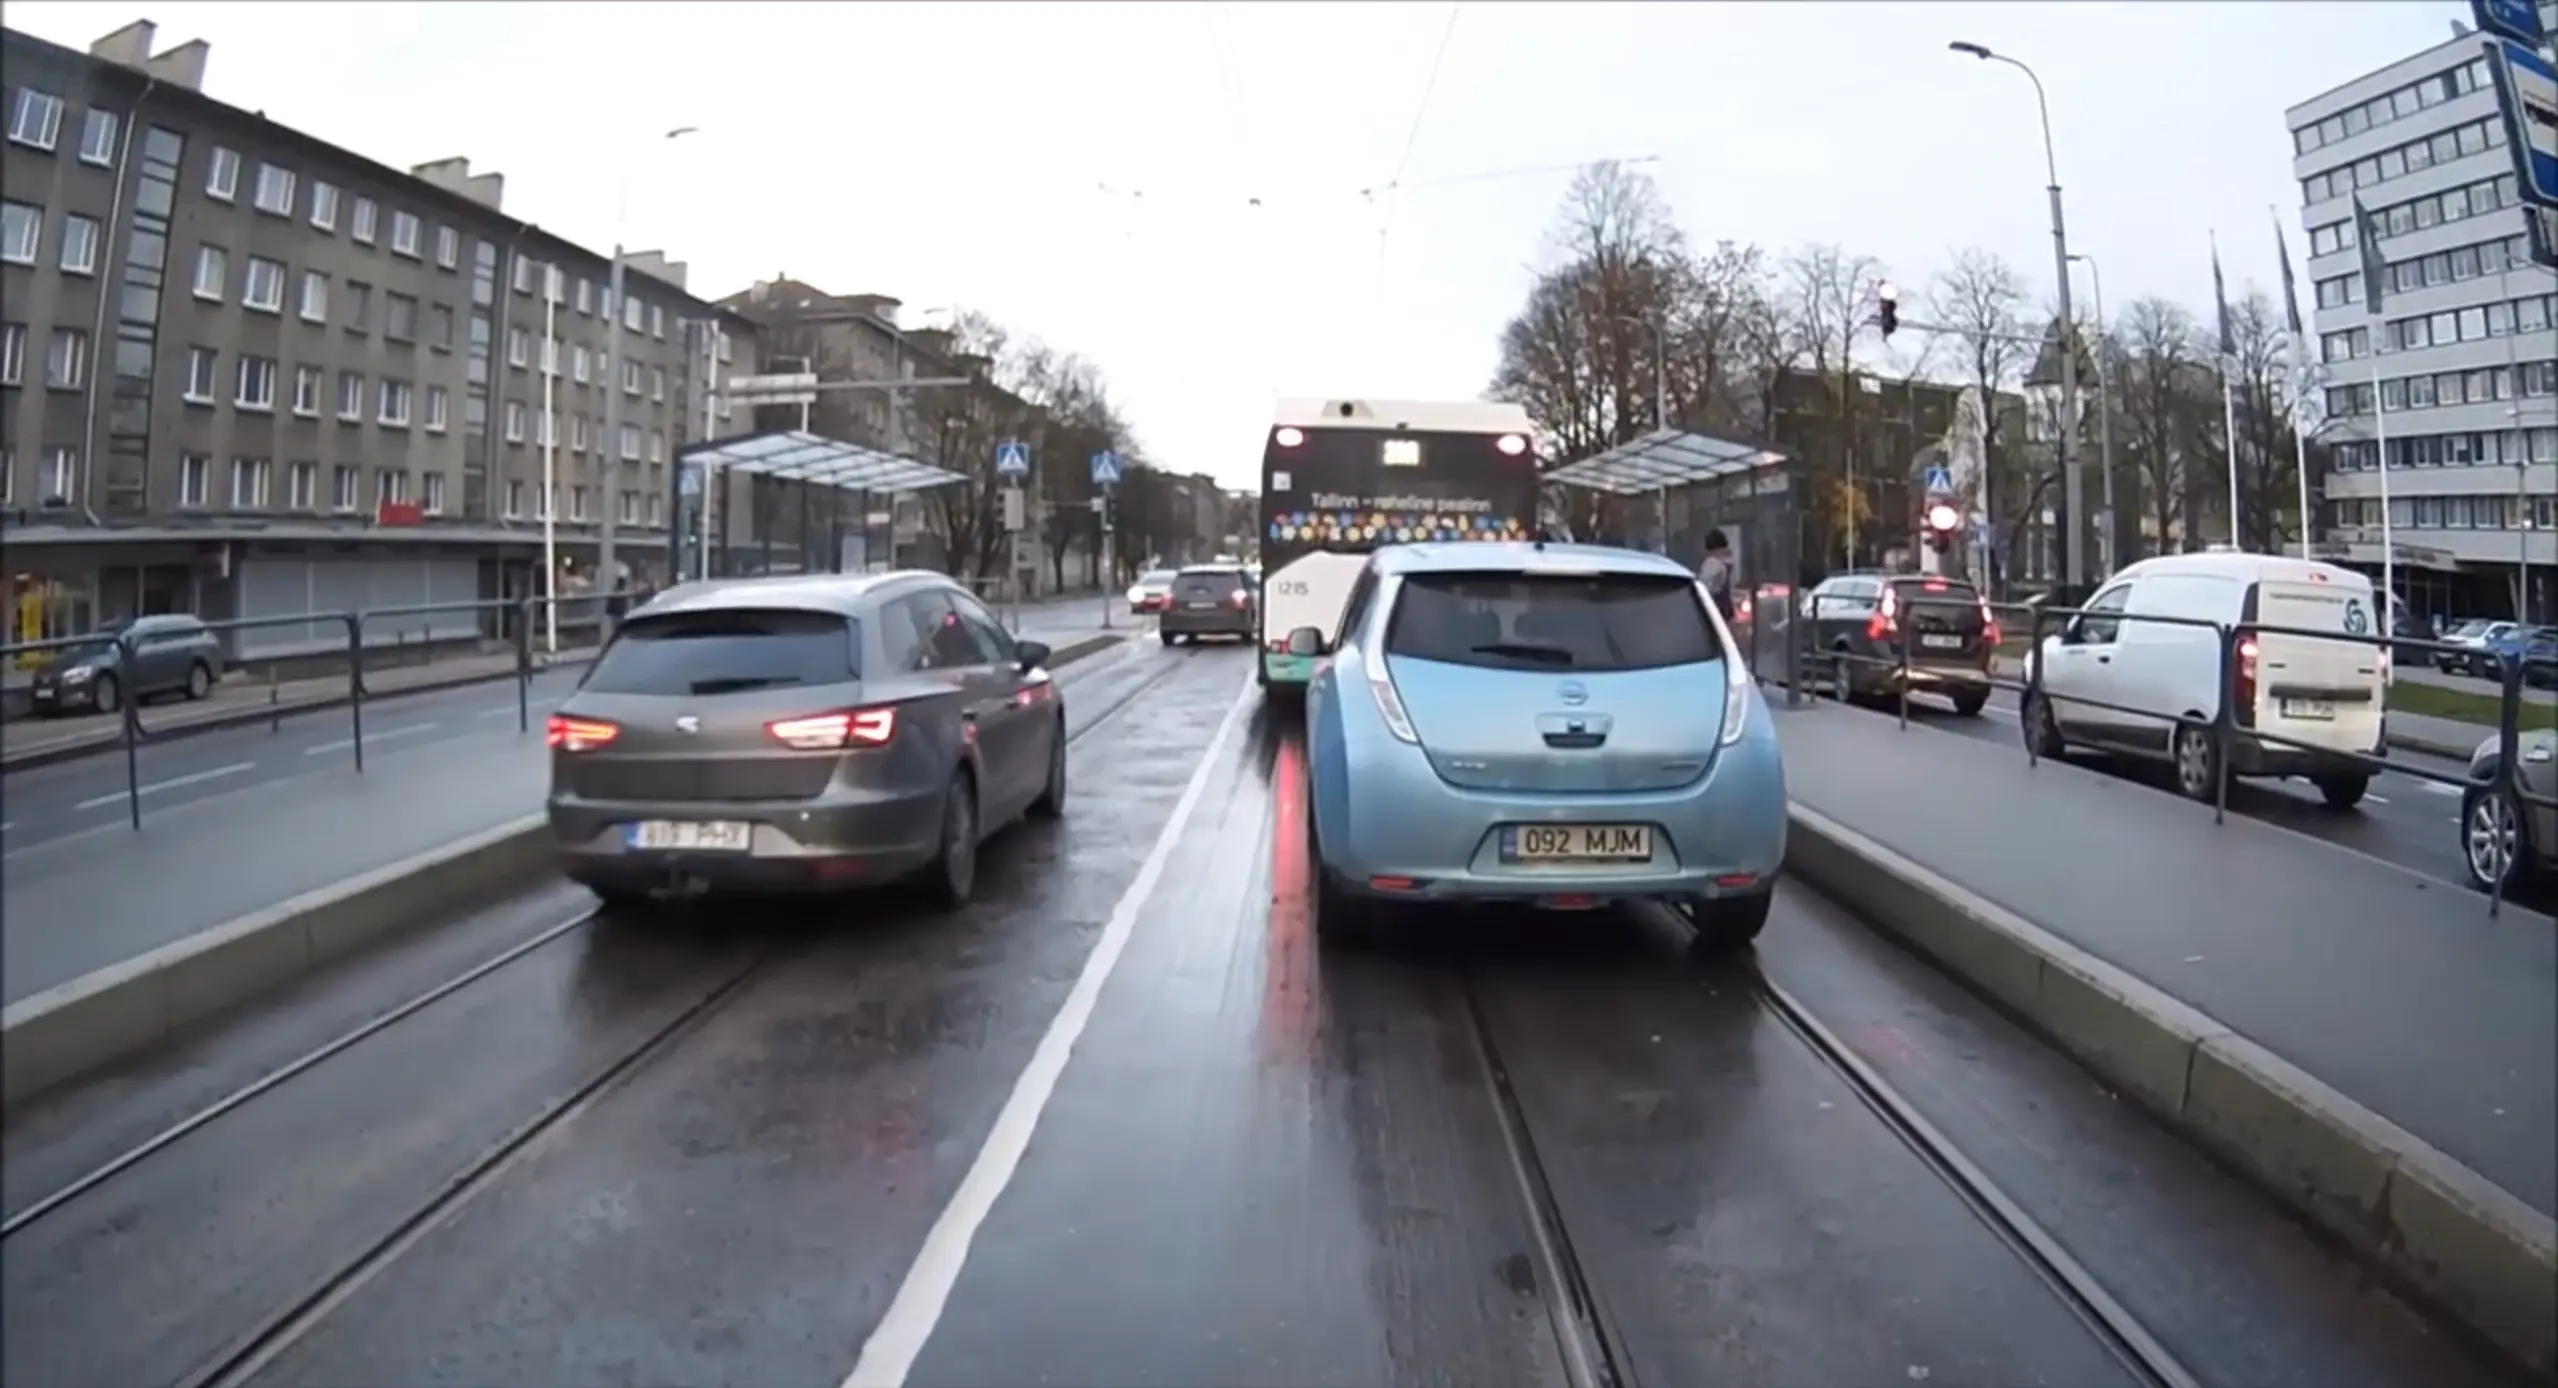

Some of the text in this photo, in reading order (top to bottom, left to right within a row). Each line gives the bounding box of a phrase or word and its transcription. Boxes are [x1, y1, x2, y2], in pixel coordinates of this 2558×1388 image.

[1311, 492, 1358, 509] Tallinn
[1525, 828, 1641, 854] 092 MJM
